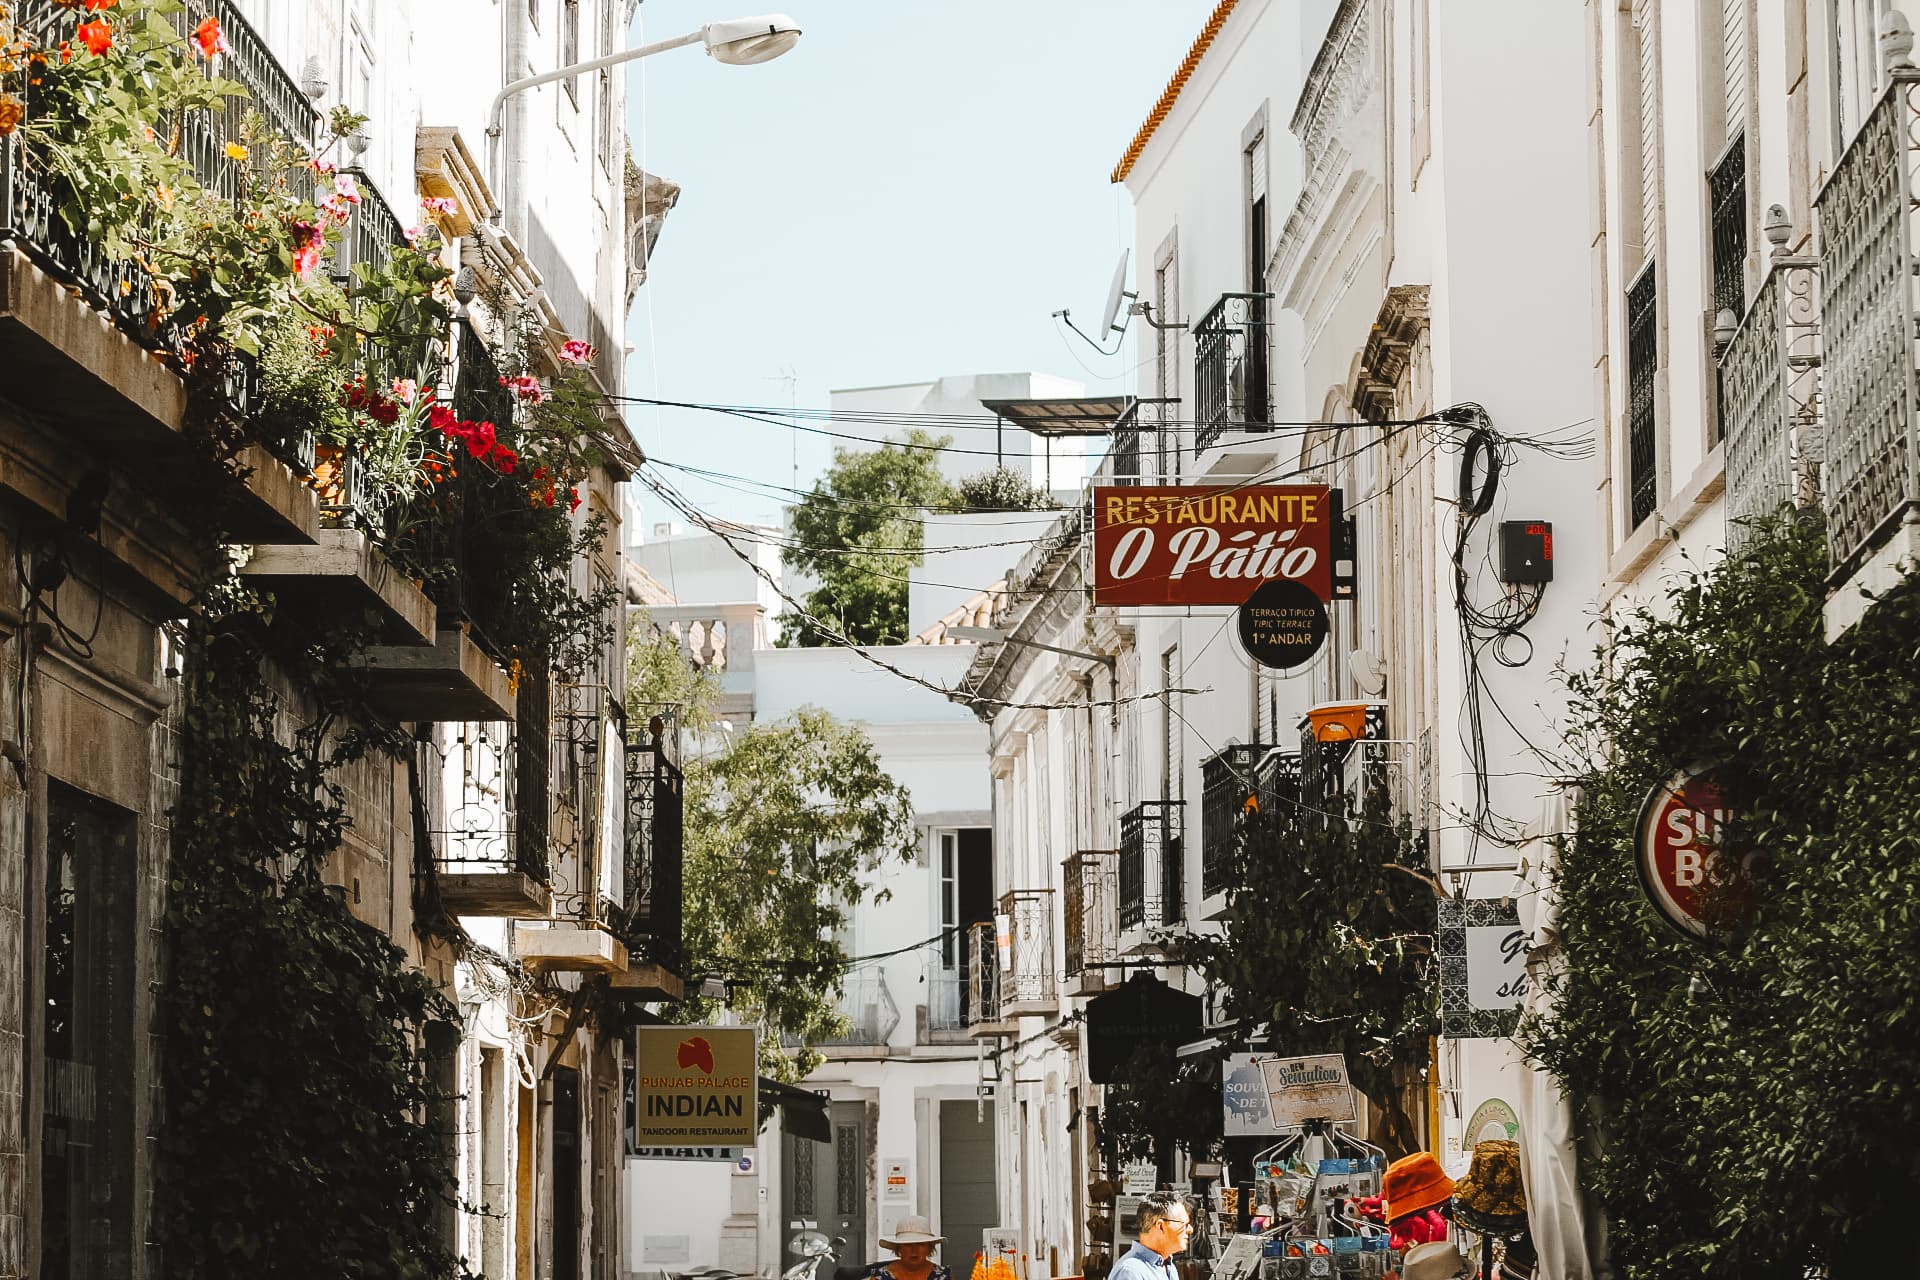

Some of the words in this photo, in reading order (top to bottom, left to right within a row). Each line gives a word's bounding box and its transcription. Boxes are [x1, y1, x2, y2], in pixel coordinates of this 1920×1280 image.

[1106, 494, 1318, 525] RESTAURANTE
[1109, 526, 1155, 580] O
[1168, 526, 1318, 581] Pátio
[1250, 608, 1287, 618] TERRAÇO
[1276, 619, 1313, 629] TERRACE
[1268, 633, 1313, 645] ANDAR
[1279, 1065, 1342, 1086] Sensation
[641, 1077, 694, 1088] PUNJAB
[697, 1077, 749, 1088] PALACE
[1225, 1082, 1264, 1093] SOUV
[647, 1094, 743, 1117] INDIAN
[1239, 1098, 1257, 1108] DE
[641, 1127, 687, 1136] TANDOORI
[689, 1127, 749, 1136] RESTAURANT
